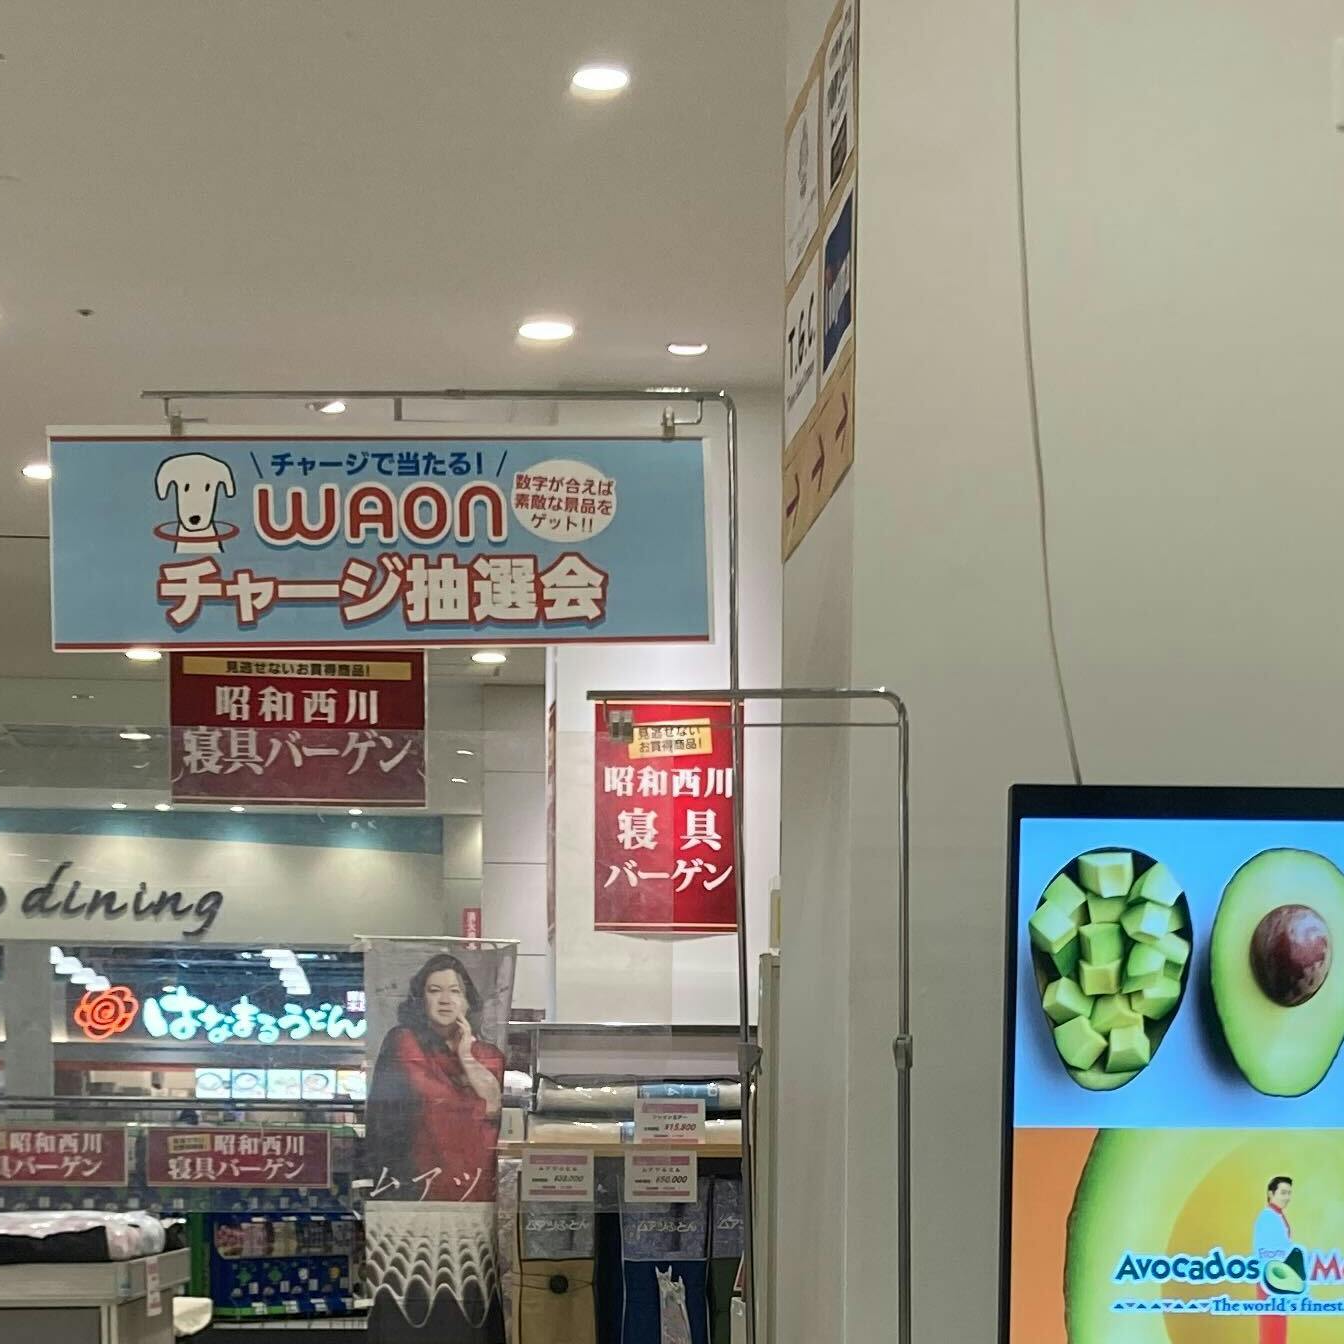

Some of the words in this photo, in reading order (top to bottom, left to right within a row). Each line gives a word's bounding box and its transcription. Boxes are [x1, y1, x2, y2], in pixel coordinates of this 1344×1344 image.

[516, 474, 614, 496] 数字が合えば
[258, 484, 504, 542] WAON
[514, 493, 613, 516] 素敵な景品を
[159, 555, 609, 628] チャージ抽選会
[215, 685, 379, 725] 昭和西川
[183, 725, 413, 776] 寝具バーゲン
[604, 766, 734, 799] 昭和西川
[604, 857, 734, 893] バーゲン
[21, 861, 224, 937] dining
[142, 985, 368, 1045] はなまるうどん
[9, 1132, 103, 1154] 昭和西川
[213, 1134, 305, 1156] 昭和西川
[168, 1156, 305, 1180] 寝具バーゲン
[1114, 1250, 1259, 1281] Avocados
[1213, 1299, 1240, 1312] The
